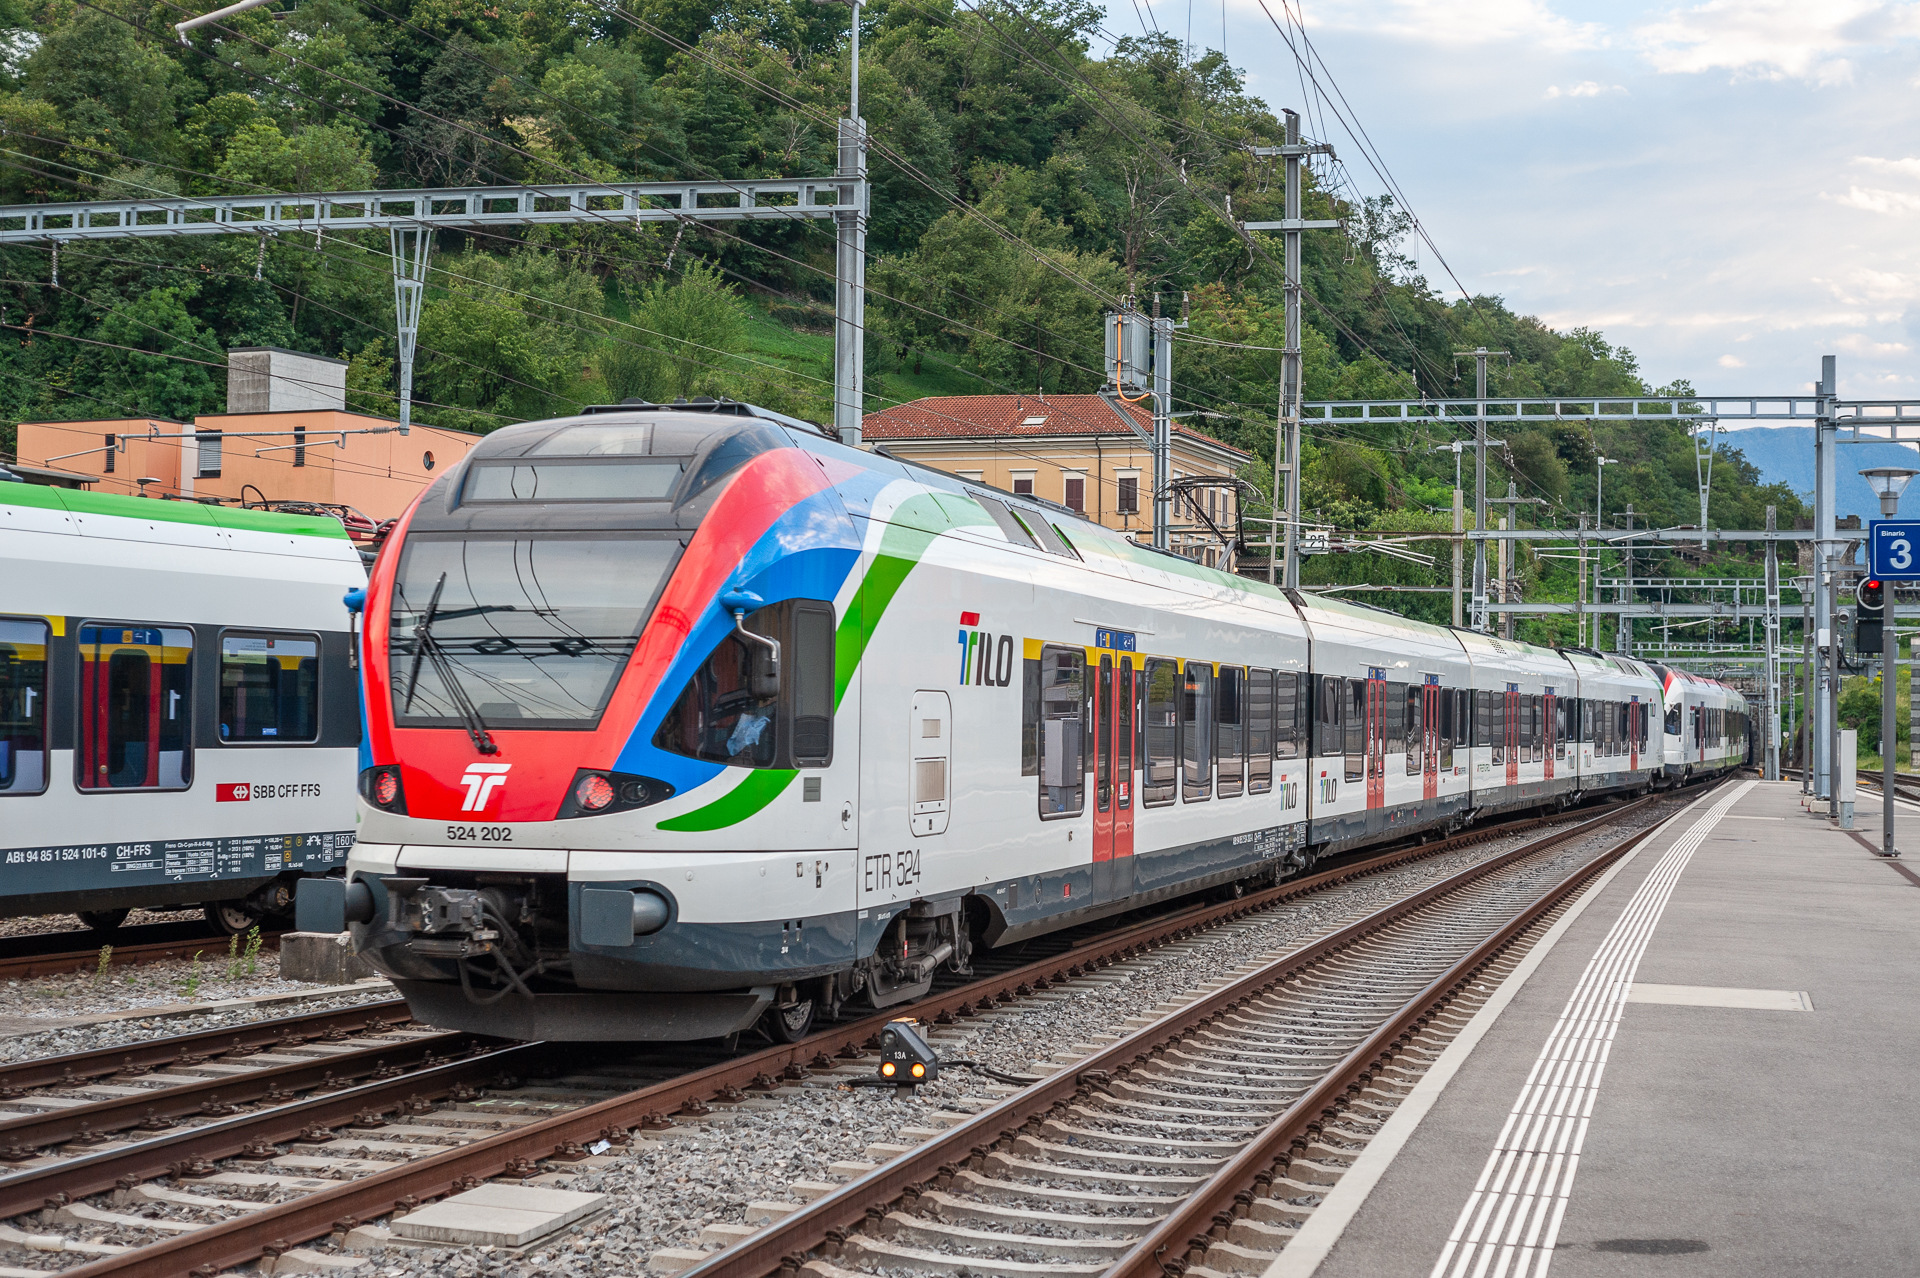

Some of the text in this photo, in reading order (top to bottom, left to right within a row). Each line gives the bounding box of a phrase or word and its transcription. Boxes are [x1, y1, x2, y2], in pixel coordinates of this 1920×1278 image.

[1890, 539, 1912, 569] 3
[253, 783, 321, 799] SBB CFF FFS
[336, 835, 350, 846] 160
[447, 826, 513, 842] 524 202
[6, 844, 151, 864] ABt 94 85 1 524 101-6 CH-FFS
[865, 848, 921, 892] ETR 524
[894, 1051, 907, 1060] 13A
